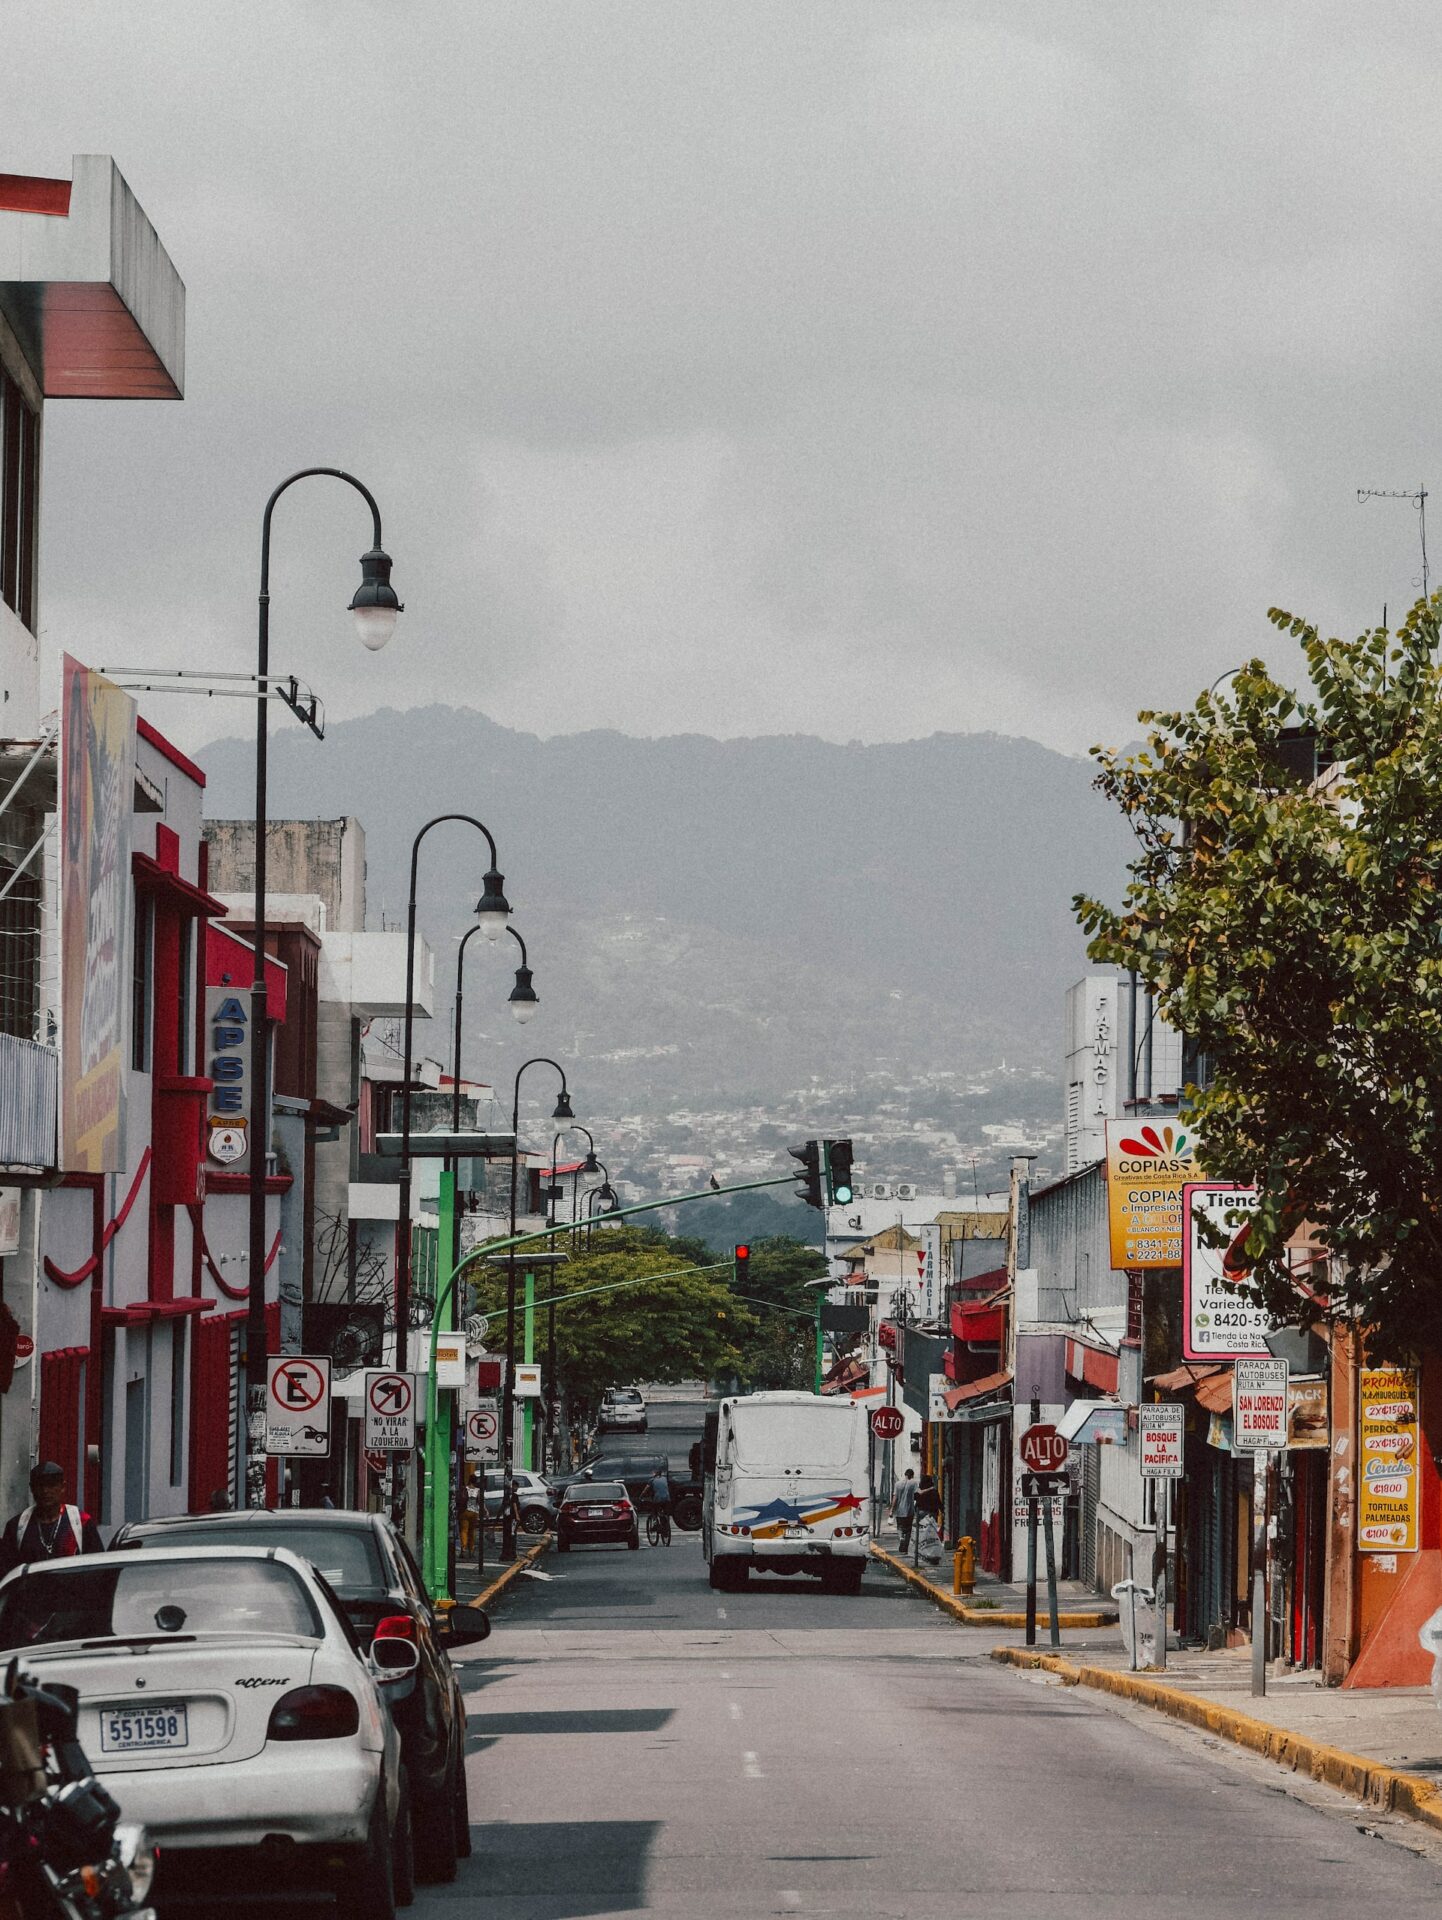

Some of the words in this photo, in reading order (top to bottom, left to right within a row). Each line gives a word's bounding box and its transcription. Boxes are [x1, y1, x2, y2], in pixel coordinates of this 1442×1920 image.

[214, 998, 247, 1111] APSE
[1094, 997, 1110, 1116] FARMACIA
[1119, 1159, 1179, 1173] COPIAS
[1132, 1215, 1139, 1224] A
[1137, 1239, 1183, 1248] 8341-73
[926, 1242, 934, 1316] FARMACIA
[1212, 1332, 1237, 1340] Tienda
[1240, 1332, 1248, 1340] La
[1227, 1340, 1249, 1348] Costa
[1273, 1362, 1284, 1370] DE
[1239, 1371, 1285, 1379] AUTOBUSES
[1238, 1381, 1254, 1389] RUTA
[1239, 1396, 1252, 1411] SAN
[1254, 1396, 1284, 1411] LORENZO
[373, 1417, 383, 1426] NO
[385, 1417, 407, 1426] VIRAR
[874, 1416, 902, 1430] ALTO
[1243, 1414, 1251, 1429] EL
[1253, 1414, 1279, 1429] BOSQUE
[381, 1427, 388, 1436] A
[389, 1427, 399, 1436] LA
[1364, 1425, 1399, 1433] PERROS
[1146, 1433, 1177, 1442] BOSQUE
[1024, 1436, 1064, 1460] ALTO
[1156, 1443, 1167, 1453] LA
[1368, 1503, 1409, 1511] TORTILLAS
[1365, 1514, 1411, 1522] PALMEADAS
[235, 1677, 290, 1688] accent
[123, 1710, 145, 1718] COSTA
[109, 1716, 178, 1741] 551598
[117, 1738, 172, 1749] CENTROAMERICA
